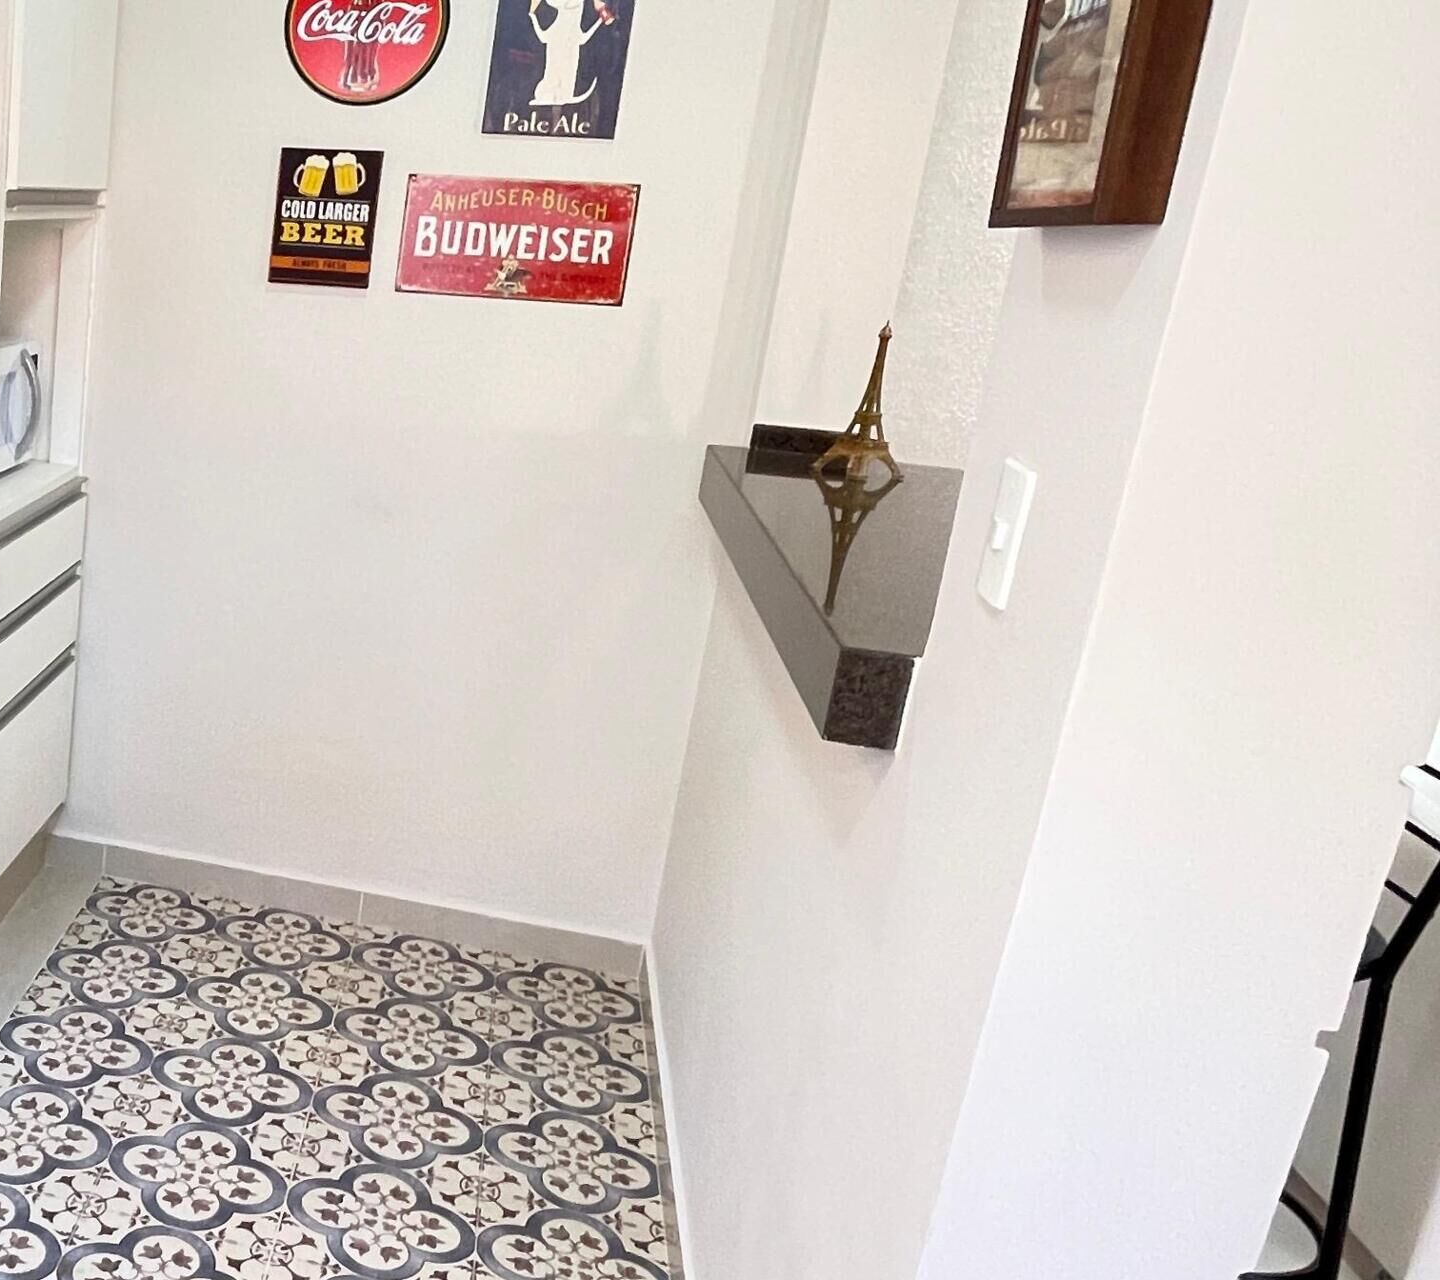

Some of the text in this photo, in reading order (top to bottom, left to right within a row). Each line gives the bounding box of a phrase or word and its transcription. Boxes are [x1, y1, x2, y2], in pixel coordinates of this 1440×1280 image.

[297, 0, 432, 45] Coca-Cola
[503, 112, 591, 134] Pale Ale
[281, 199, 370, 223] COLD LARGER
[430, 187, 608, 221] ANHEUSER-BUSCH
[280, 221, 365, 247] BEER
[413, 215, 614, 265] BUDWEISER
